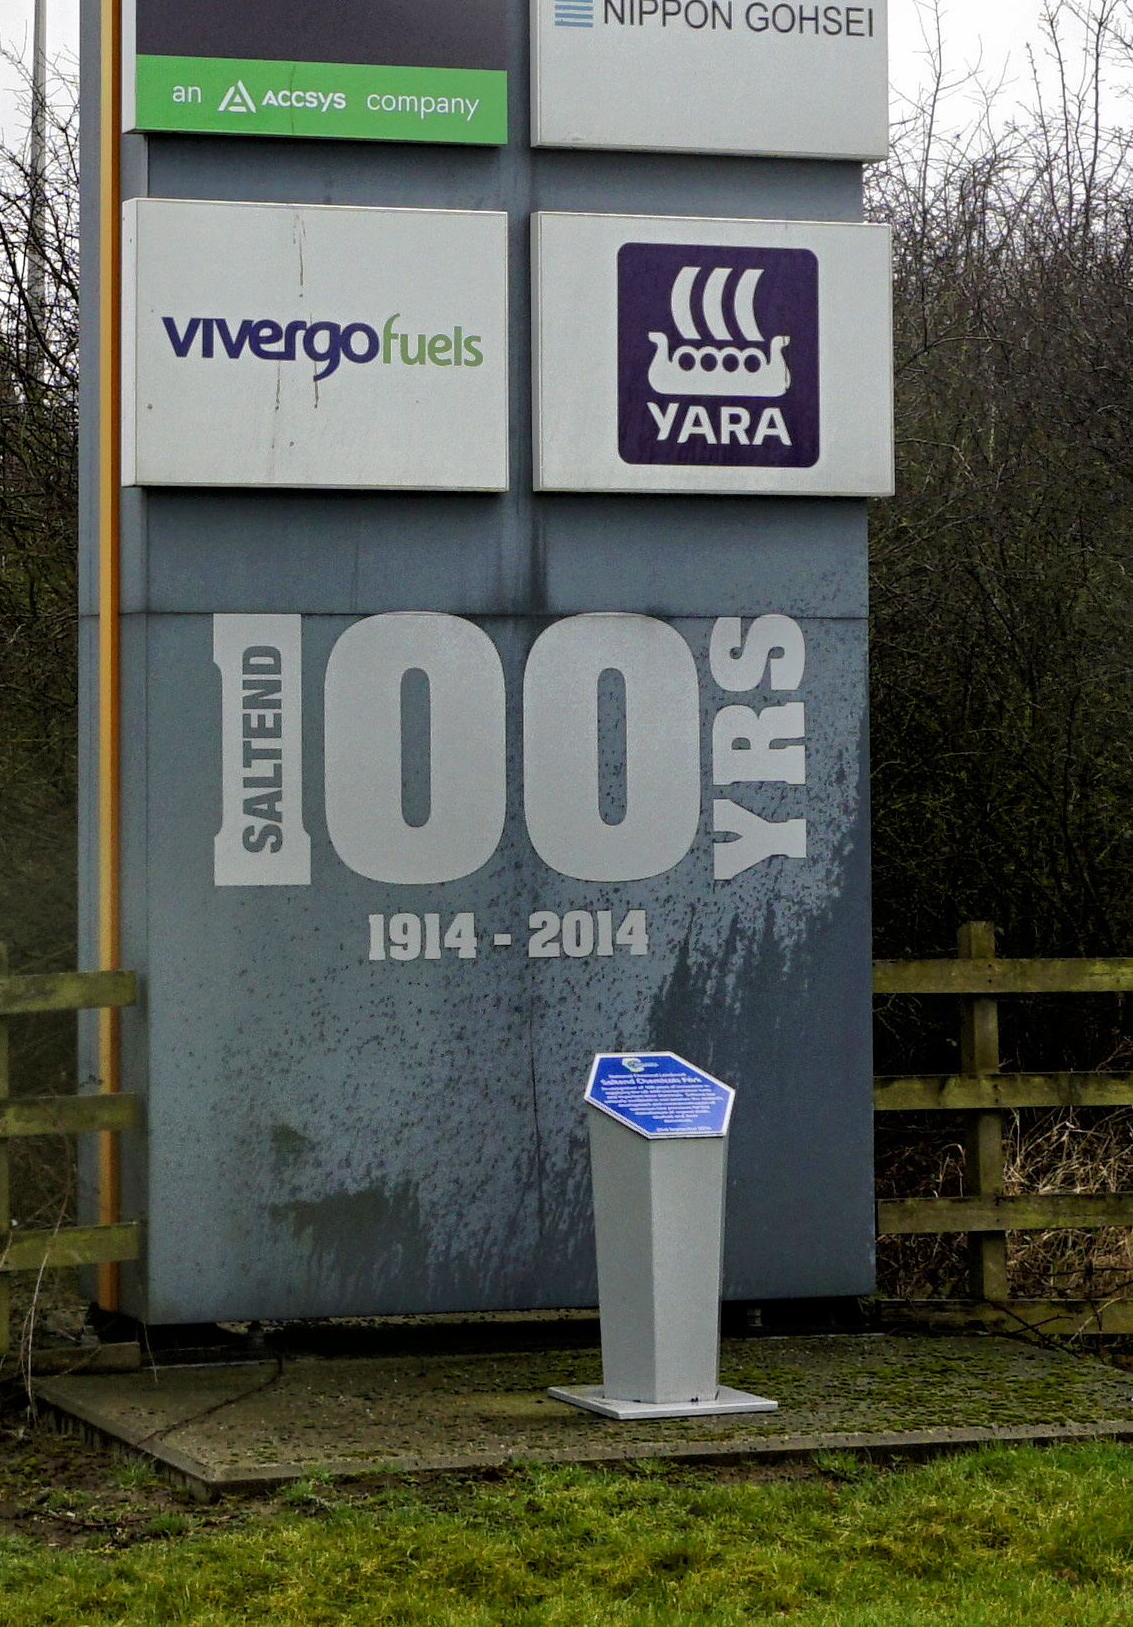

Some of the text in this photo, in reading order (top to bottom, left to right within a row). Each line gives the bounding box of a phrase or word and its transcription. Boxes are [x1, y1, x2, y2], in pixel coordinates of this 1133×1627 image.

[744, 2, 874, 38] GOHSEI
[172, 82, 202, 104] an
[366, 92, 480, 121] company
[646, 402, 792, 447] YARA
[213, 611, 701, 886] 100
[242, 644, 284, 854] SALTEND
[710, 613, 807, 882] YRS
[368, 913, 478, 961] 1914
[528, 909, 649, 958] 2014
